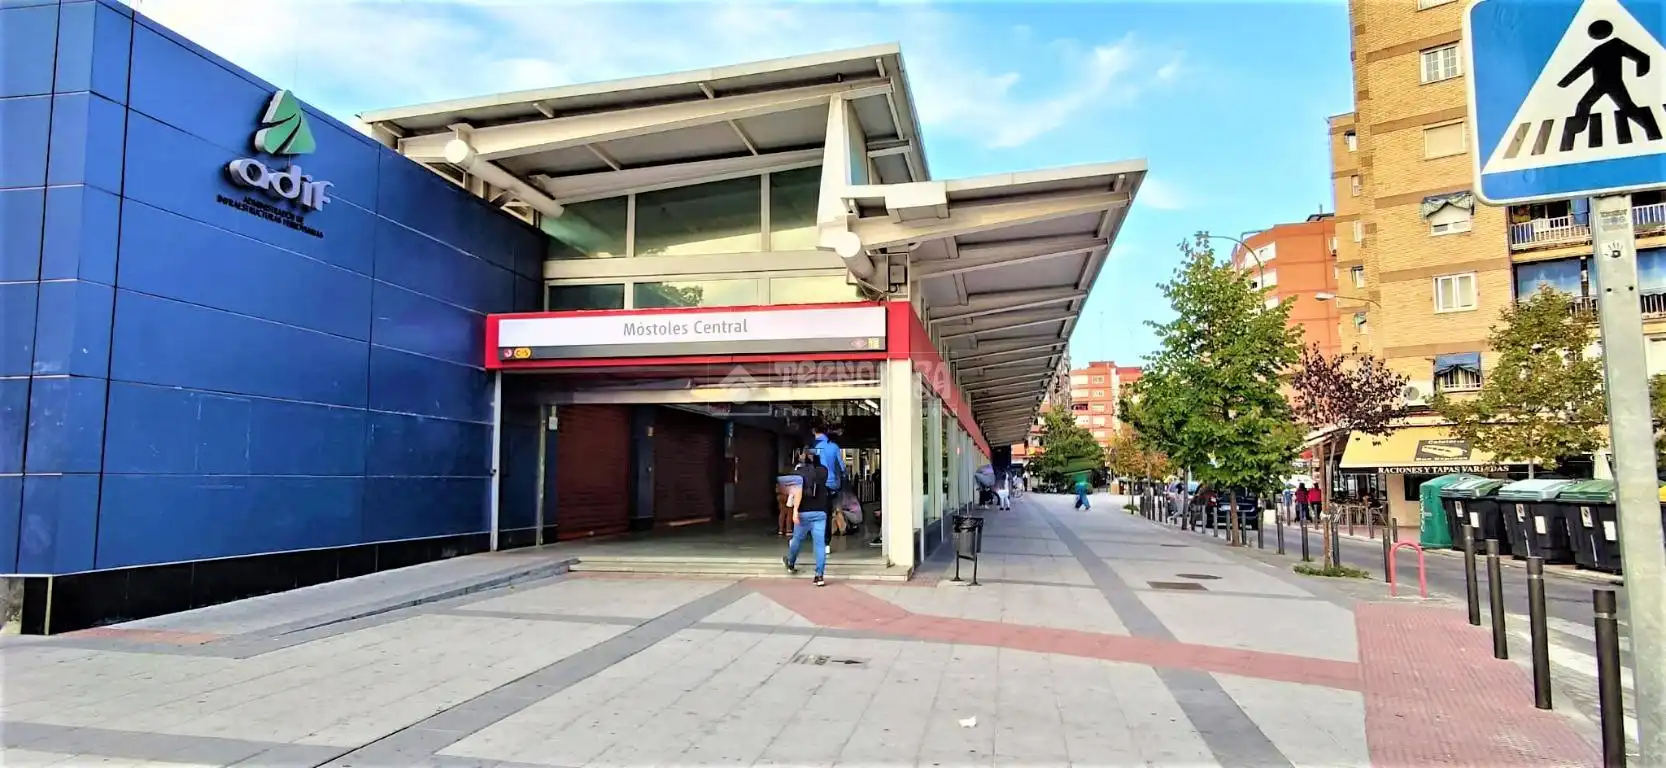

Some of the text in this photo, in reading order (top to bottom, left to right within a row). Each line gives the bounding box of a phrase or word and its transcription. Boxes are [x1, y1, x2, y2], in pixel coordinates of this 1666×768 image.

[229, 158, 335, 212] adif
[623, 318, 748, 336] Móstoles Central
[1378, 466, 1422, 474] RACIONES
[1432, 465, 1460, 473] TAPAS
